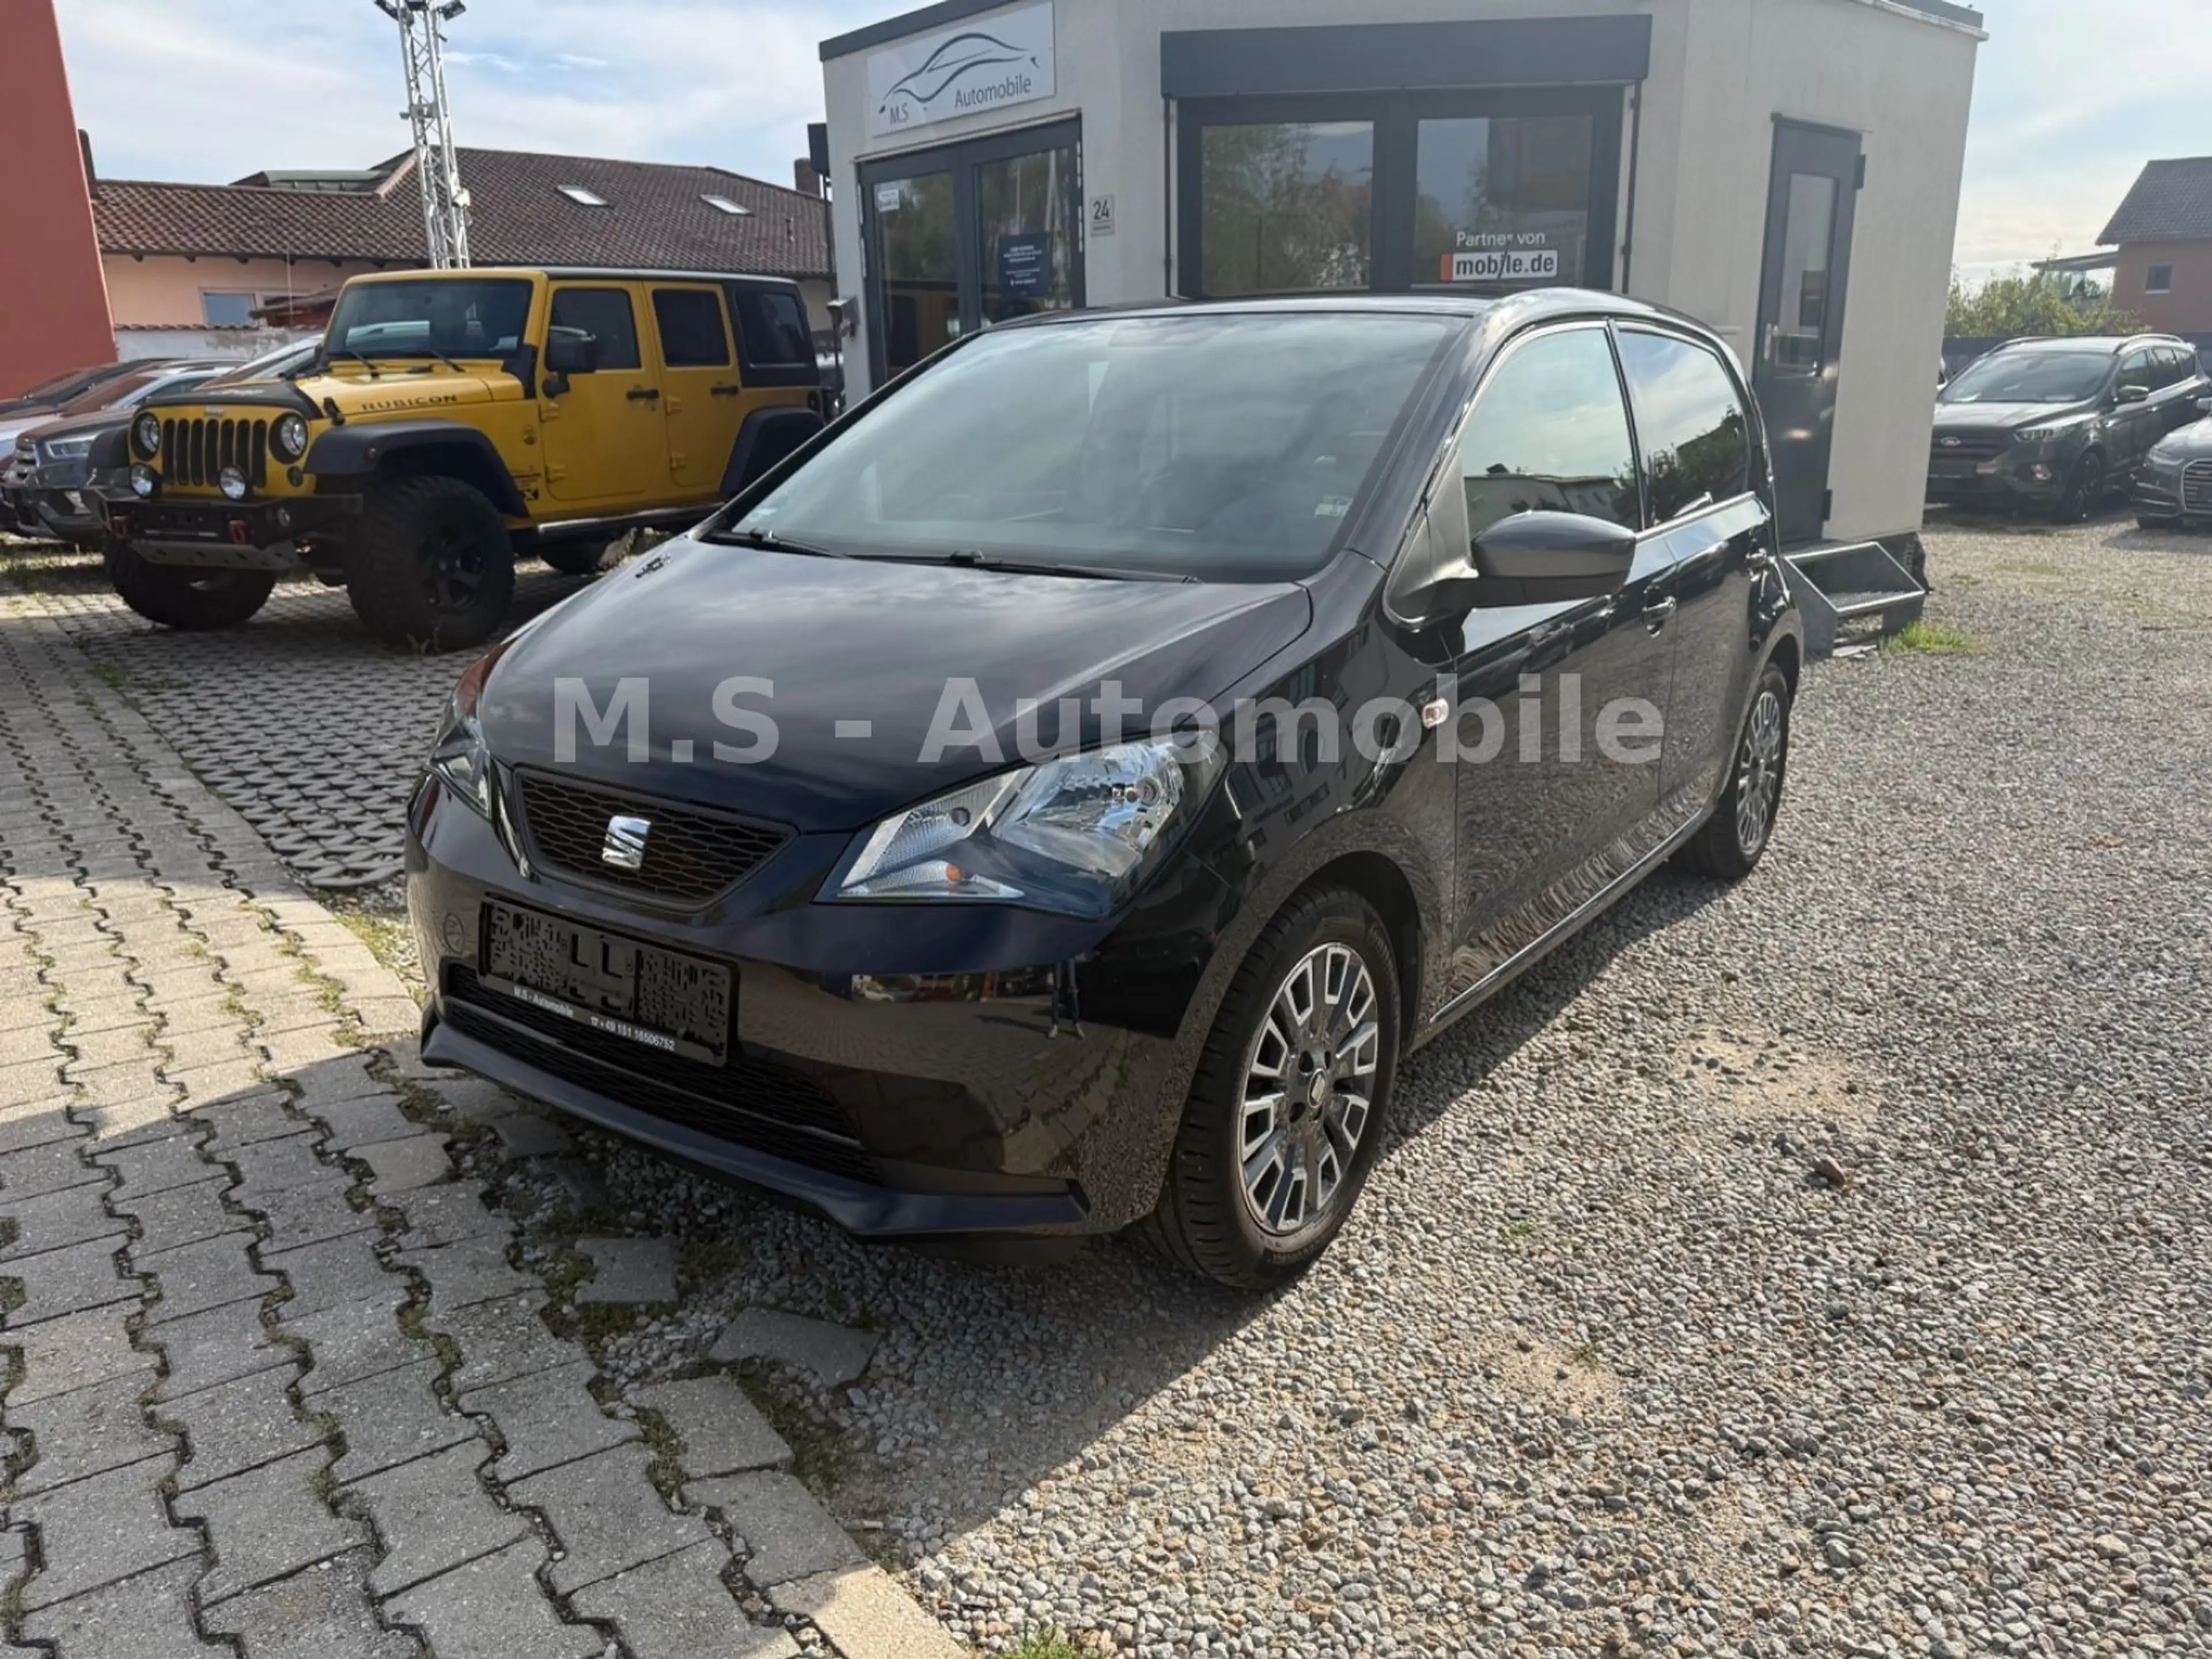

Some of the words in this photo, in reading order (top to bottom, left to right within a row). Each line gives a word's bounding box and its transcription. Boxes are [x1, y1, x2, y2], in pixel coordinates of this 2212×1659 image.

[954, 74, 1032, 108] Automobile
[1093, 200, 1109, 219] 24
[1456, 231, 1514, 247] Partner
[1517, 232, 1546, 244] von
[361, 394, 457, 411] RUBICON
